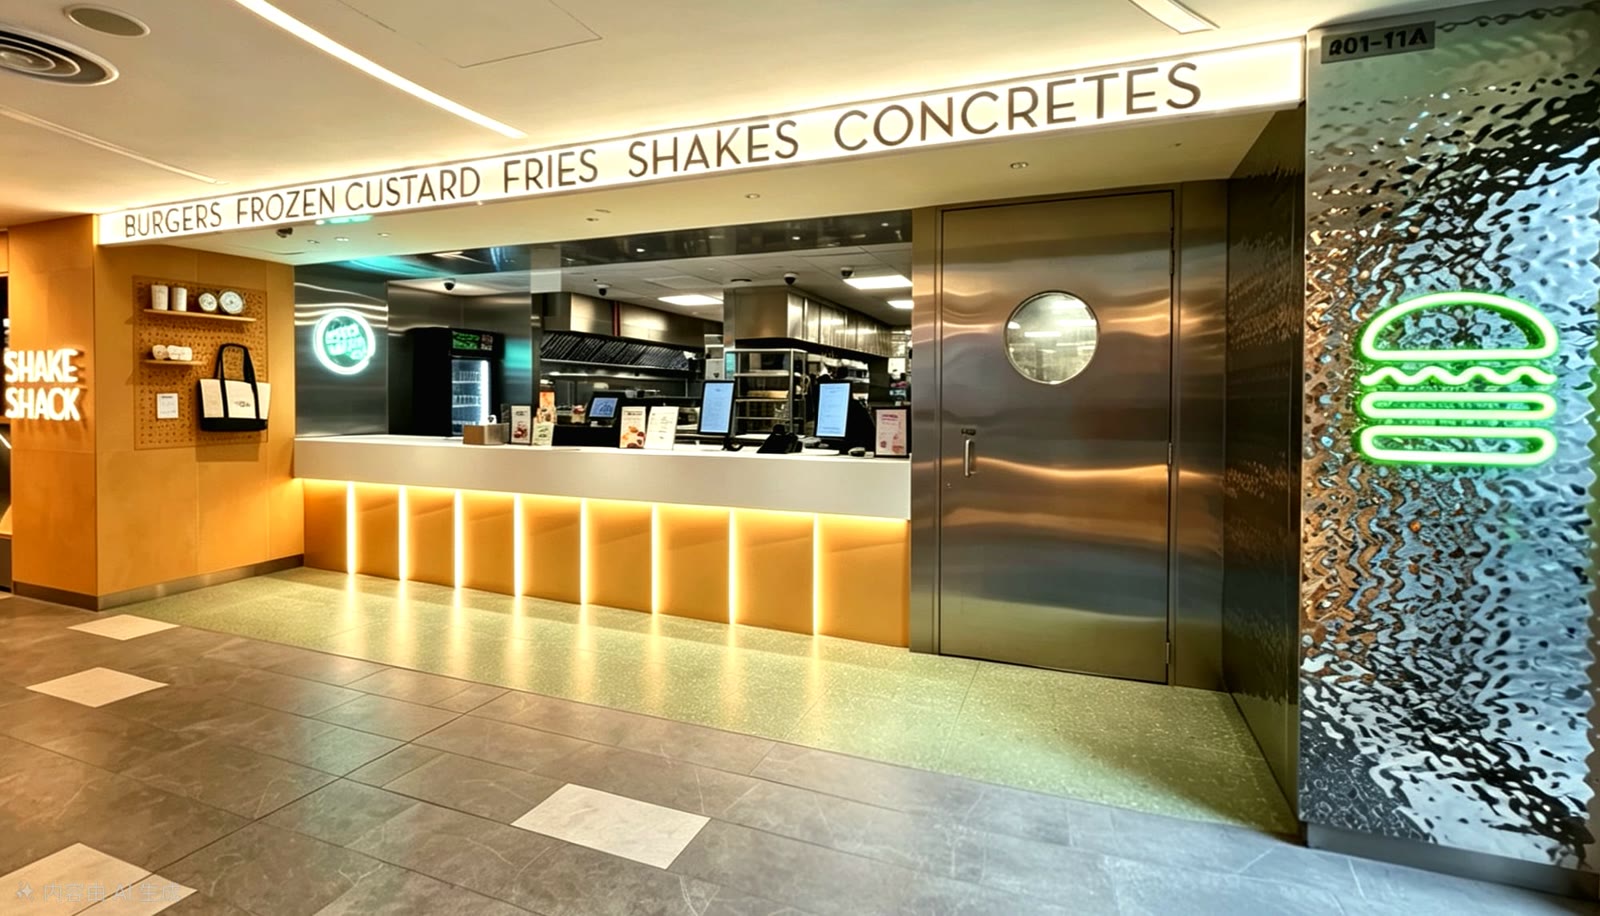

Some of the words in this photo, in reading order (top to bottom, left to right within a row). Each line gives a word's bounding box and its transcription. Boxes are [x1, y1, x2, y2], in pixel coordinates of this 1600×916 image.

[124, 202, 222, 238] BURGERS
[236, 186, 336, 224] FROZEN
[345, 166, 481, 211] CUSTARD
[503, 148, 599, 193] FRIES
[628, 119, 799, 178] SHAKES
[834, 61, 1201, 151] CONCRETES
[3, 348, 79, 383] SHAKE
[4, 386, 81, 422] SHACK
